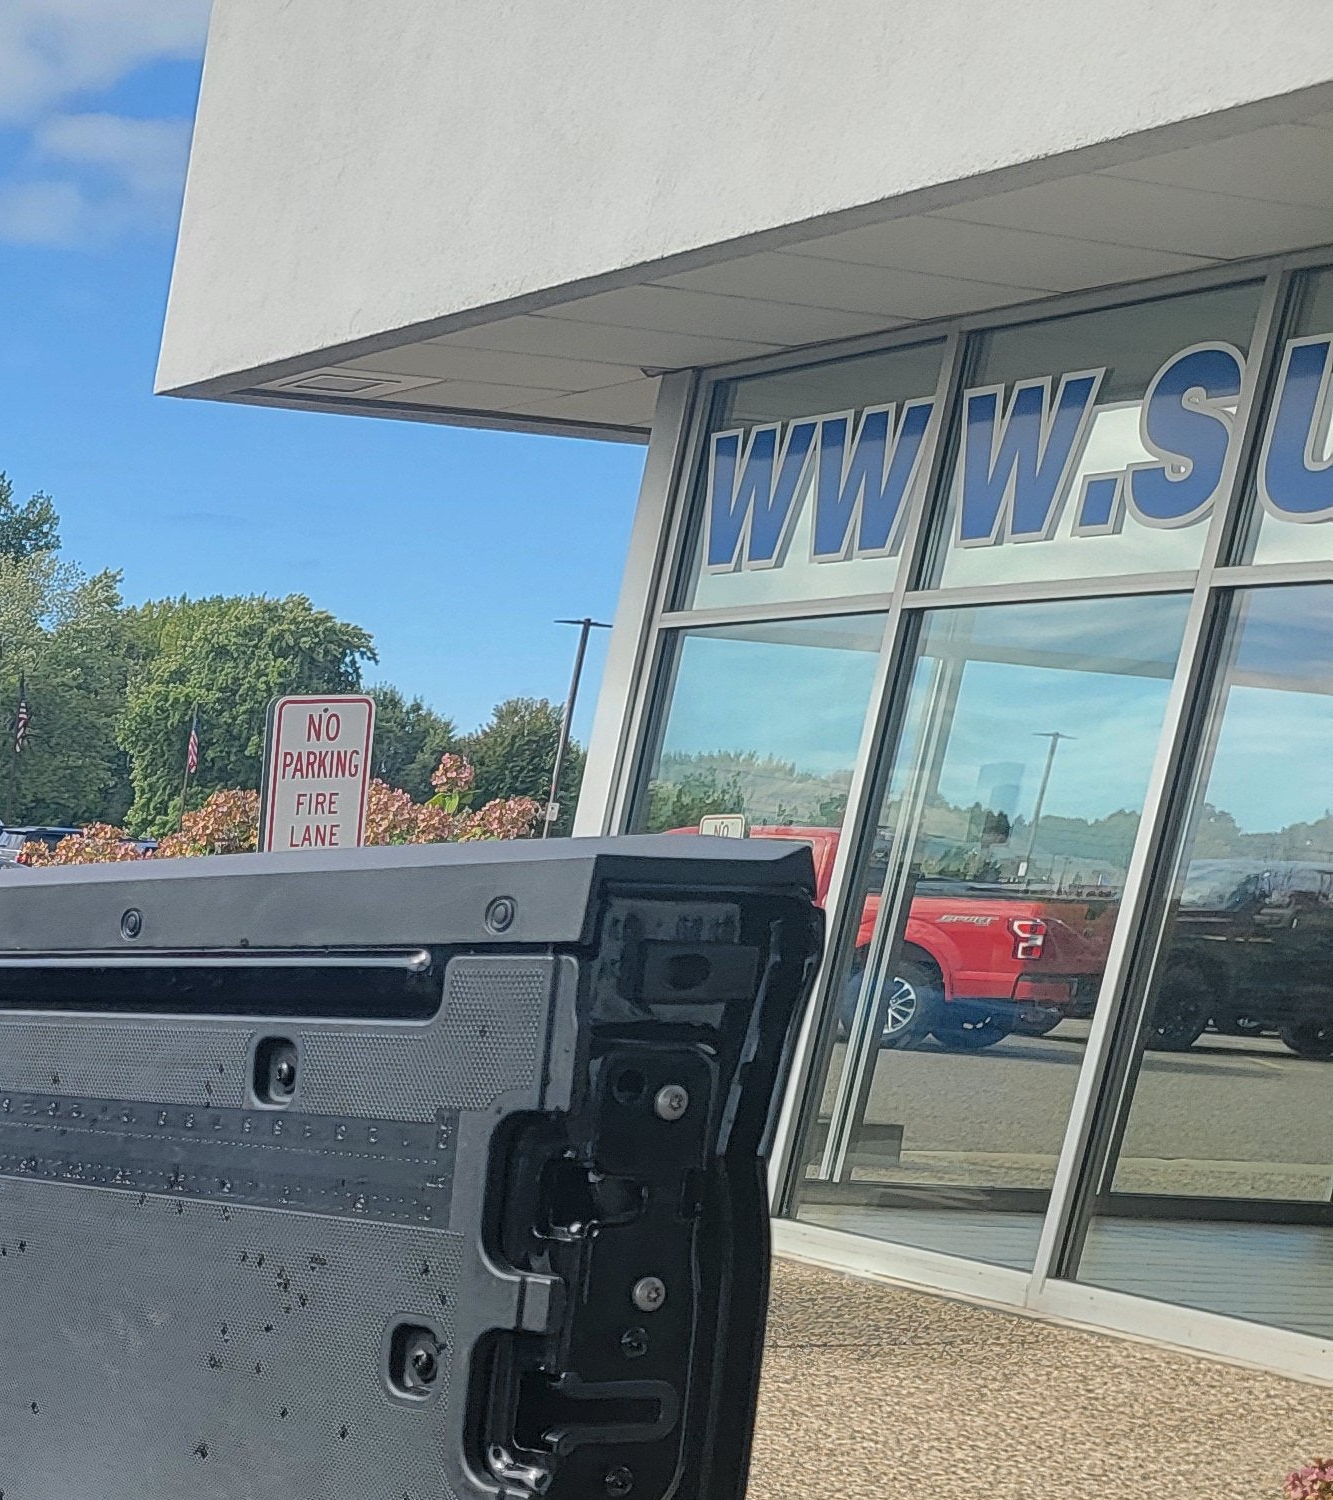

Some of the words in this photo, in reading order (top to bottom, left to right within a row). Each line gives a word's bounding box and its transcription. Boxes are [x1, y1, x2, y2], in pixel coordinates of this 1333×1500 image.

[307, 713, 340, 741] NO
[282, 750, 359, 779] PARKING
[296, 792, 339, 815] FIRE
[289, 823, 339, 848] LANE
